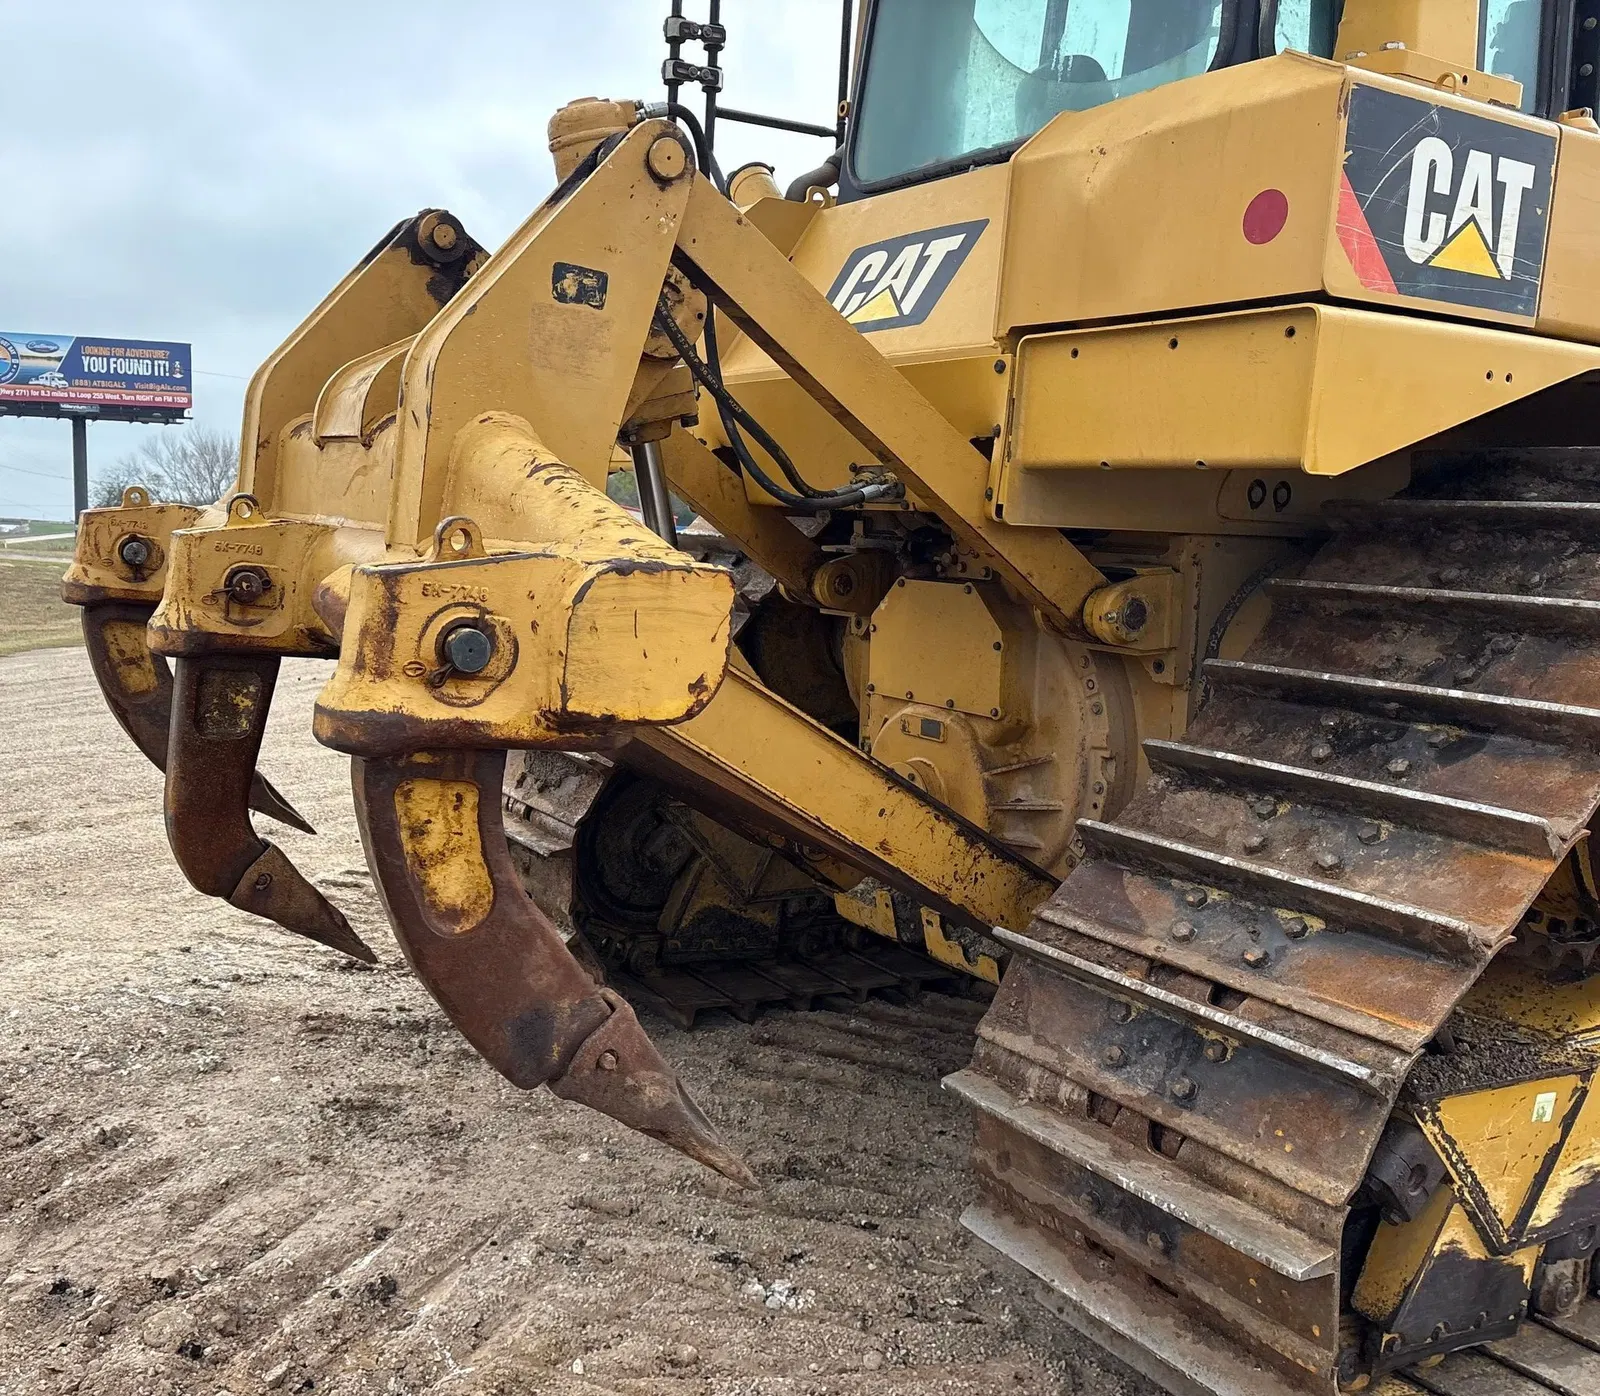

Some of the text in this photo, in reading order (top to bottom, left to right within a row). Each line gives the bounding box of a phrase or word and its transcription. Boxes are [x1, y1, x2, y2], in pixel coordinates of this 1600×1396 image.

[1403, 136, 1536, 281] CAT
[832, 233, 967, 318] CAT
[81, 345, 170, 359] LOOKING FOR ADVENTURE?
[81, 356, 170, 377] YOU FOUND IT!
[92, 380, 126, 388] ATBIGALS
[134, 382, 187, 391] VisitBigAls.com
[15, 389, 30, 397] 271)
